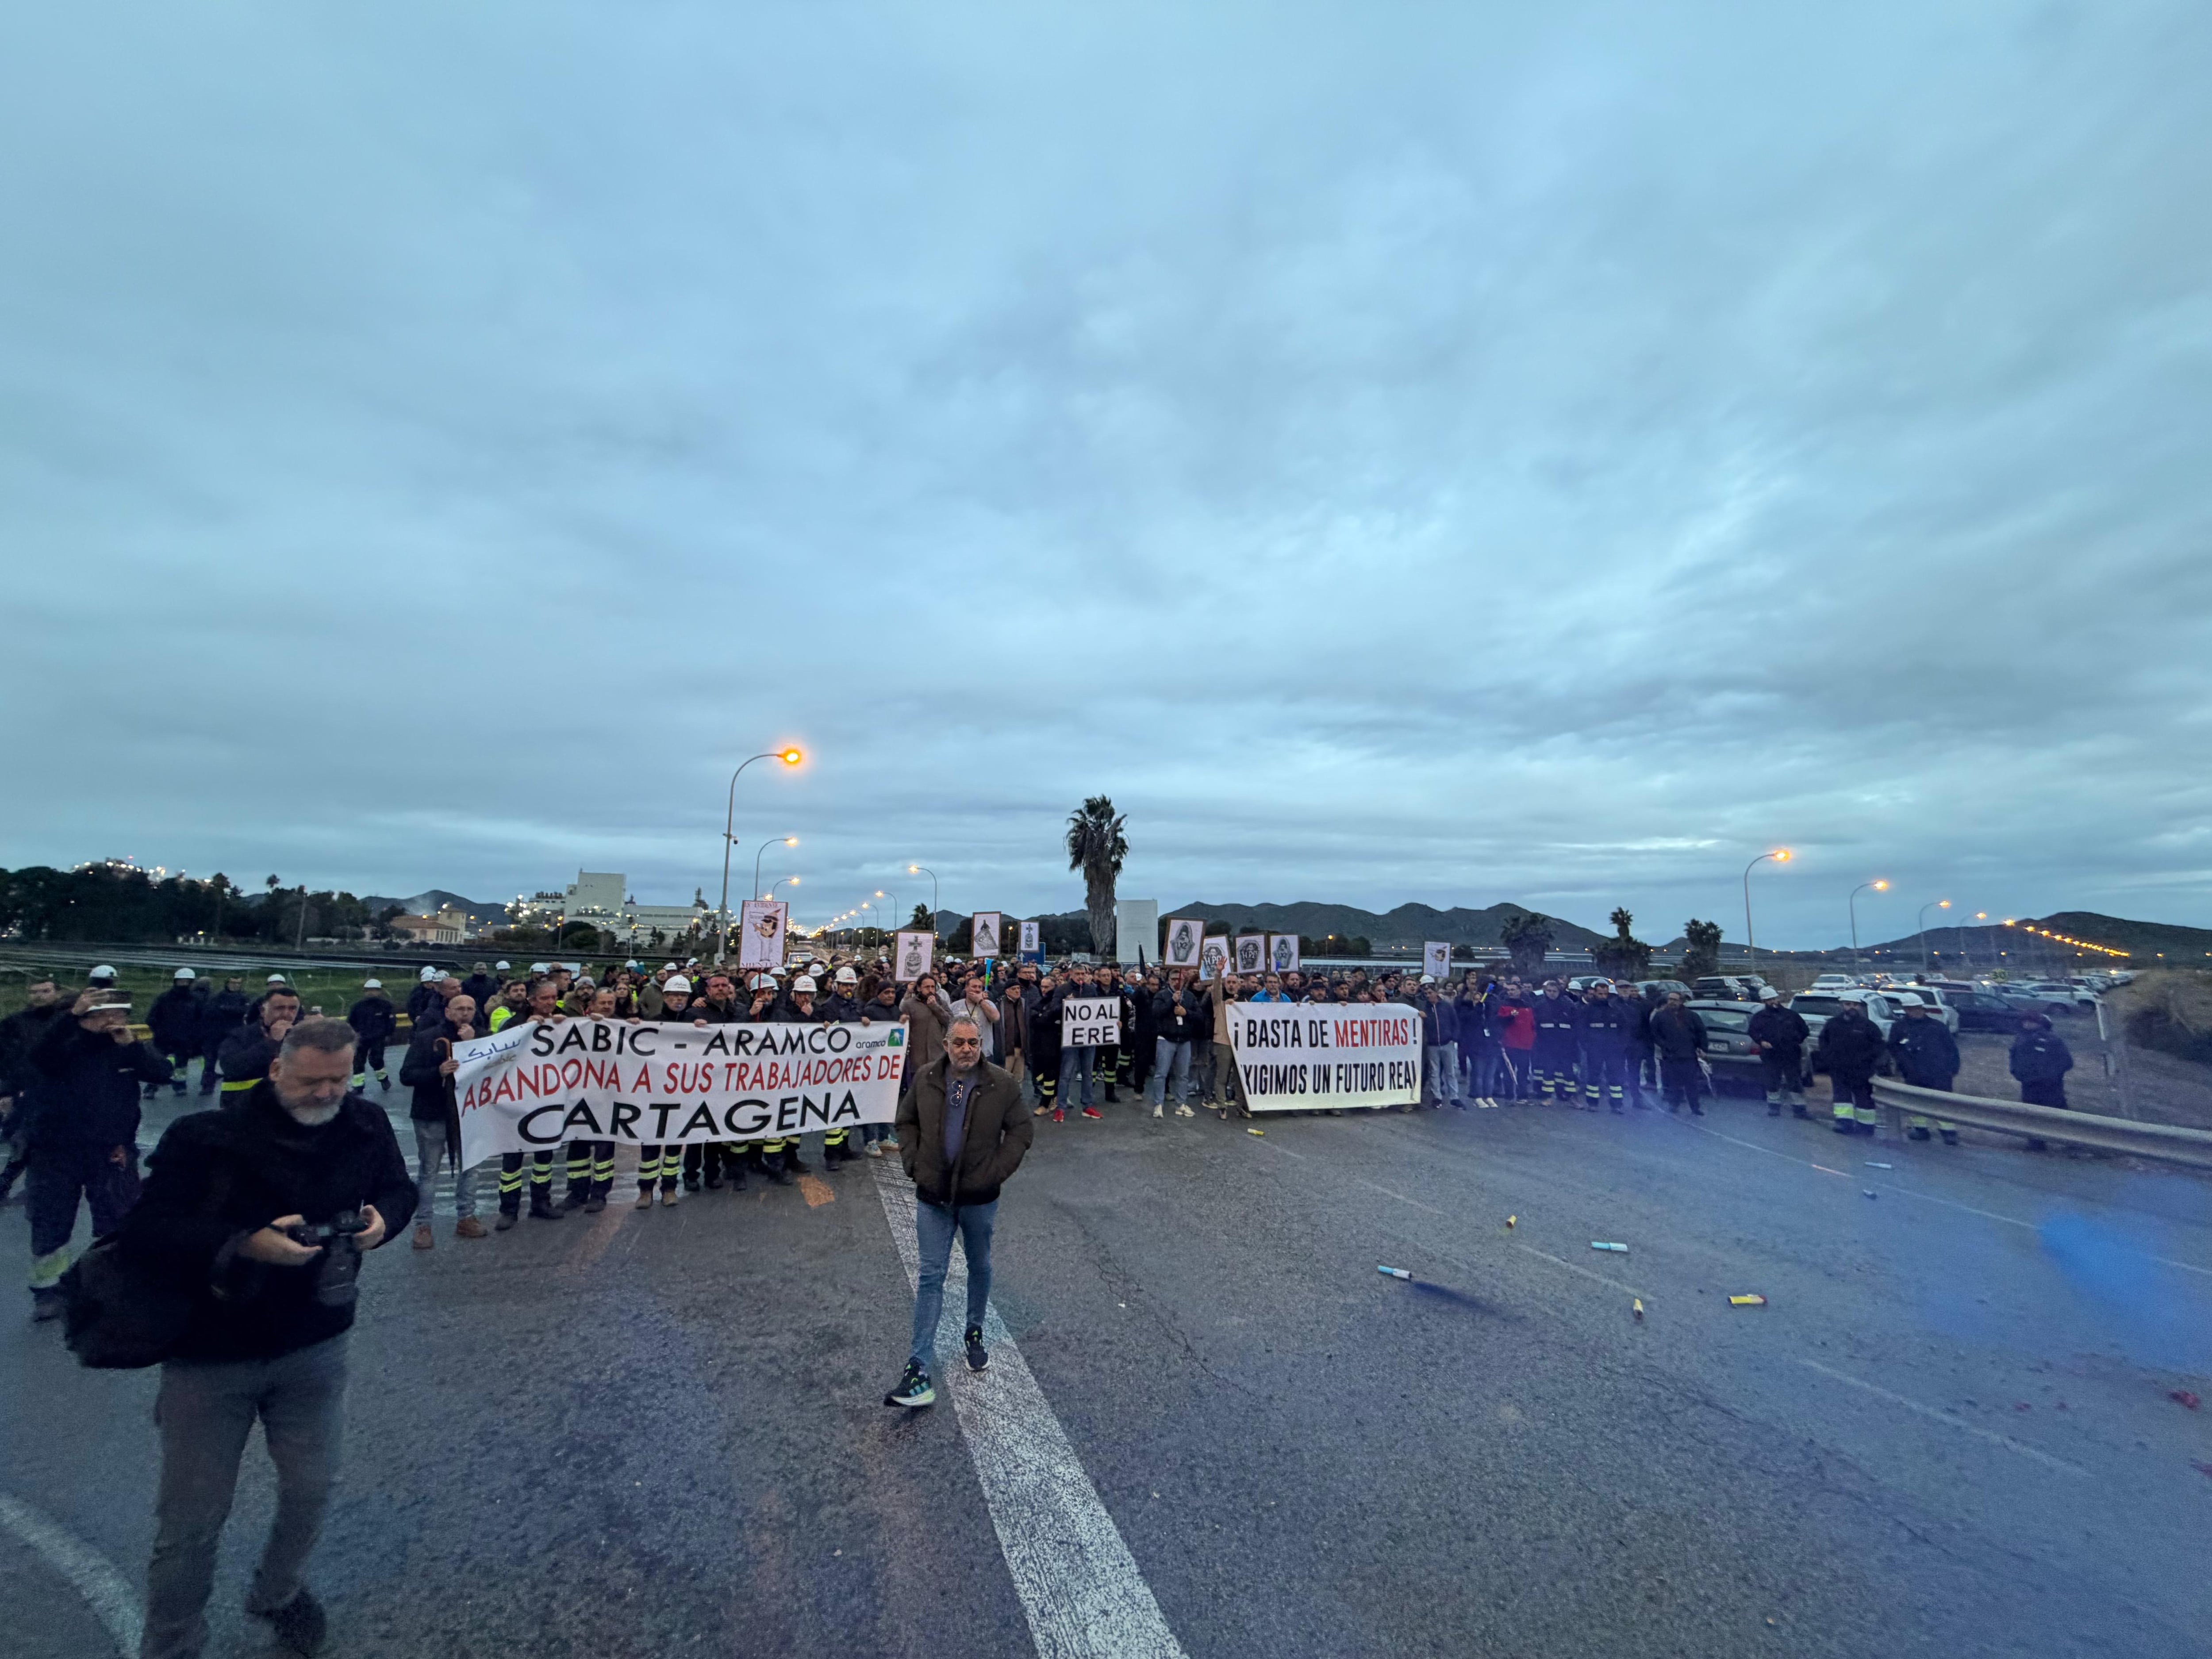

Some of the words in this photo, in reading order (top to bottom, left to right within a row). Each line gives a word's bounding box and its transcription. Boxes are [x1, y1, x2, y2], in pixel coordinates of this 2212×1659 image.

[1065, 1005, 1091, 1021] NO
[1095, 1004, 1118, 1019] AL
[531, 1022, 659, 1057] SABIC
[702, 1027, 851, 1056] ARAMCO
[856, 1040, 886, 1049] aramco
[1071, 1025, 1114, 1045] ERE
[1247, 1019, 1302, 1048] BASTA
[1309, 1019, 1329, 1048] DE
[1334, 1018, 1408, 1048] MENTIRAS
[461, 1057, 621, 1118] ABANDONA
[631, 1061, 652, 1093] A
[664, 1062, 714, 1094] SUS
[725, 1055, 872, 1091] TRABAJADORES
[877, 1055, 901, 1080] DE
[1313, 1064, 1331, 1094] UN
[1336, 1062, 1384, 1093] FUTURO
[518, 1089, 861, 1144] CARTAGENA
